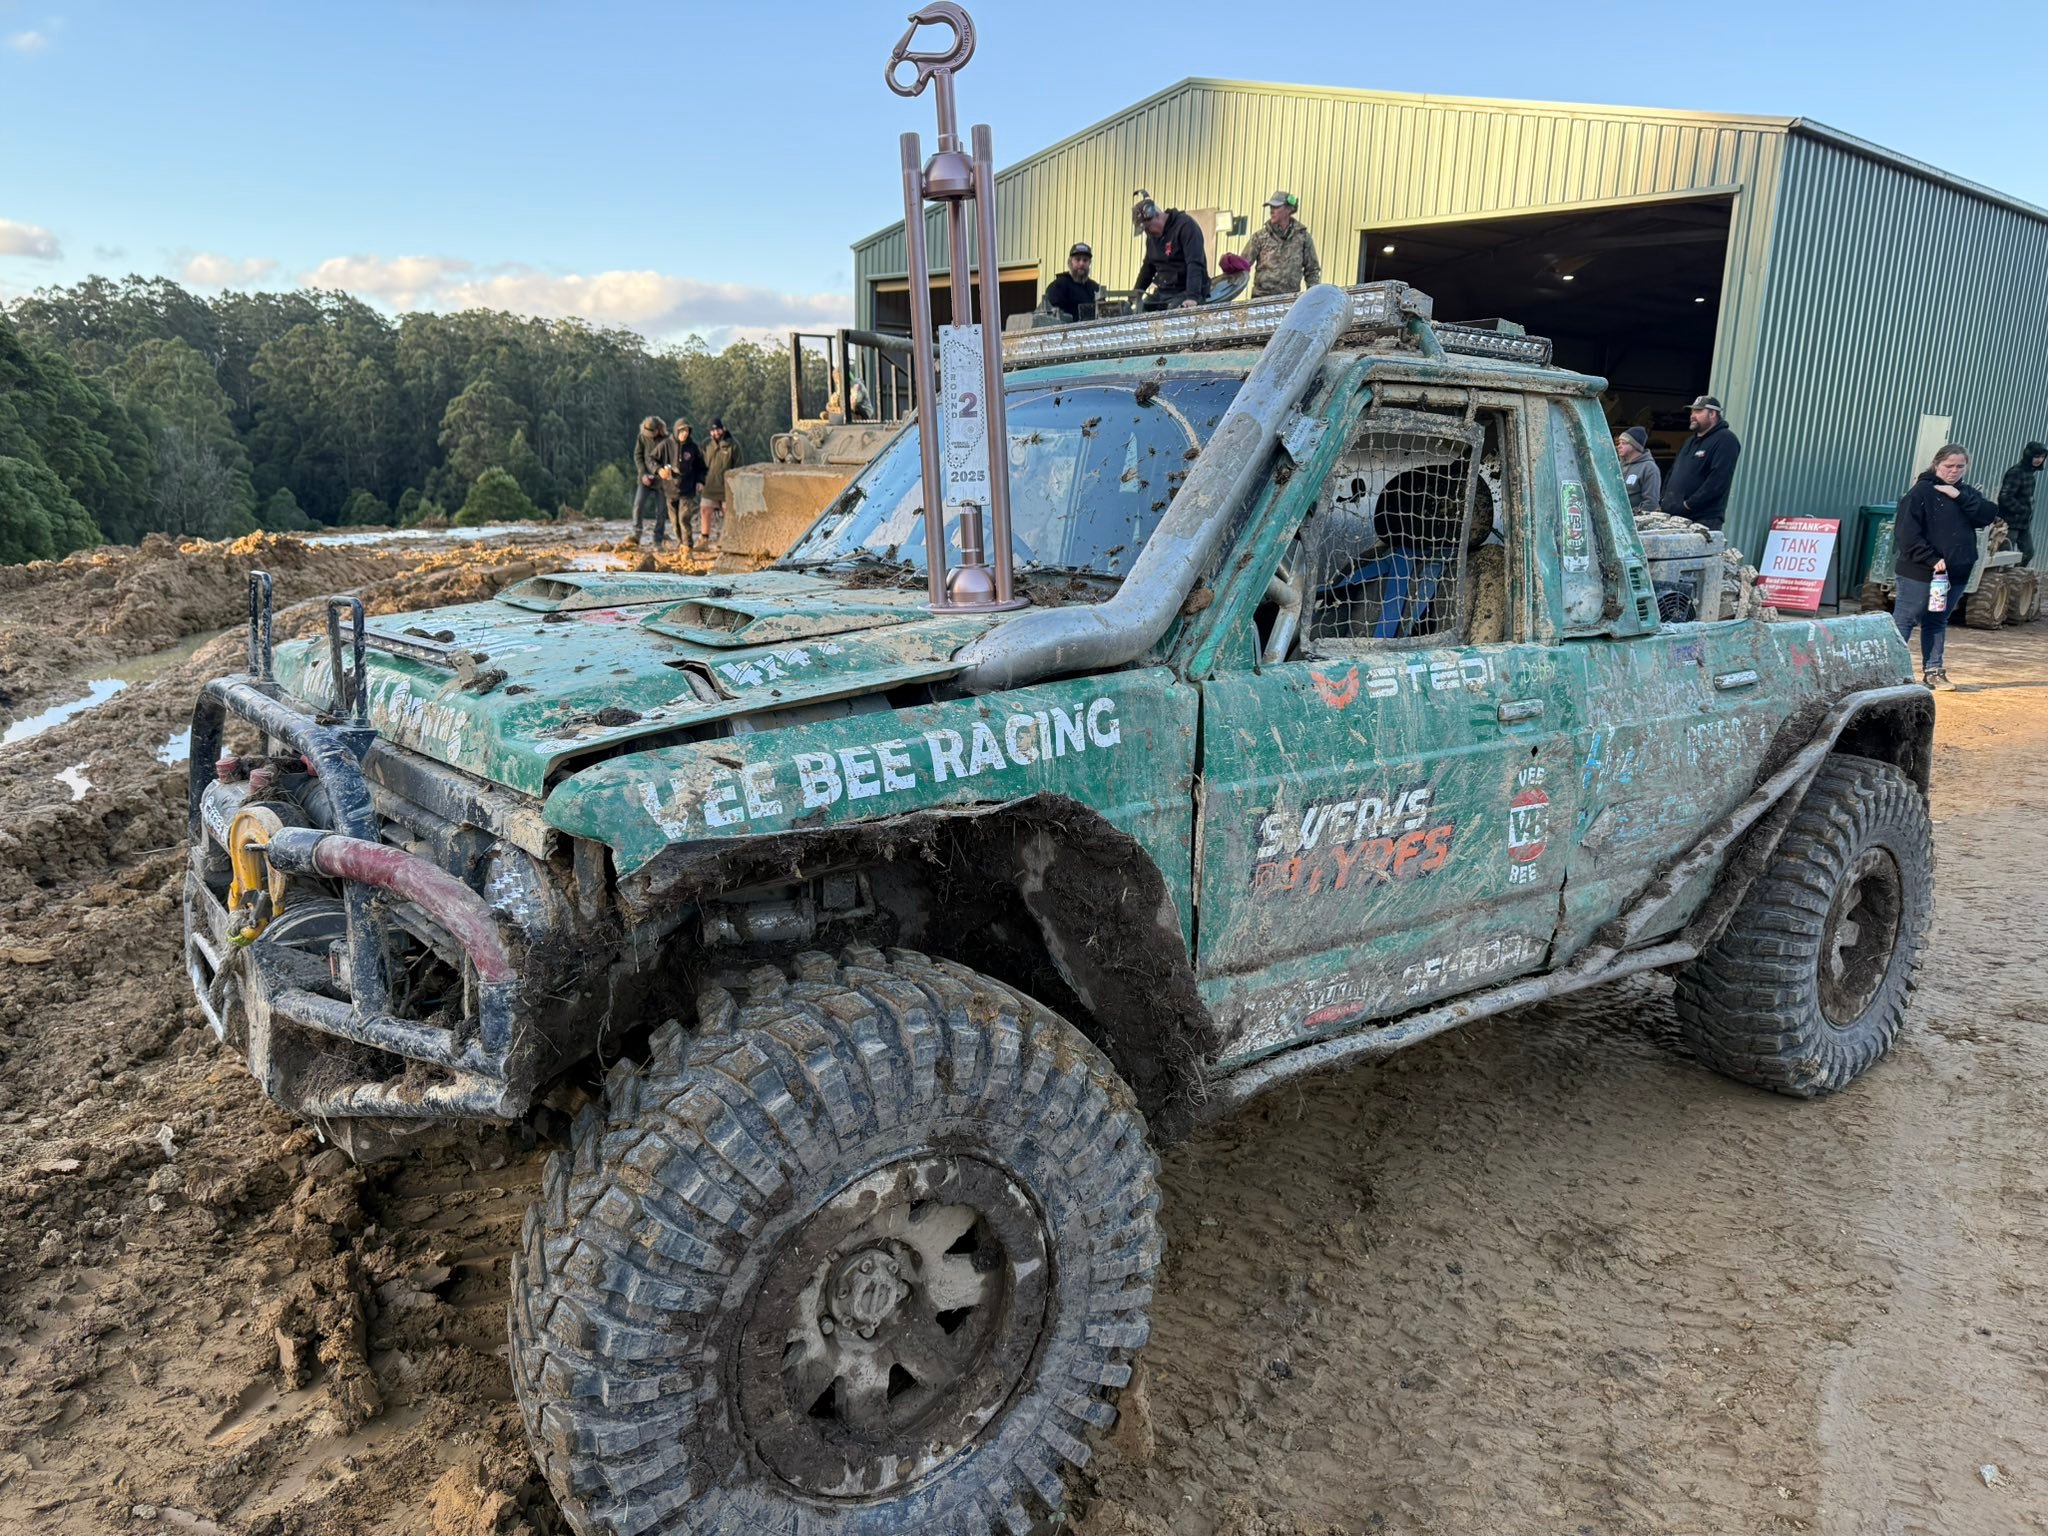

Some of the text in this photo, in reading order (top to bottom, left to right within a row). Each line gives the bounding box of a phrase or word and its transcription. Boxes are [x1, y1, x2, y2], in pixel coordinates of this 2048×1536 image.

[959, 392, 978, 418] 2
[951, 470, 986, 482] 2025
[1797, 522, 1820, 531] TANK
[1781, 538, 1820, 554] TANK
[1772, 556, 1817, 573] RIDES
[1366, 656, 1496, 699] STEDI
[637, 697, 1122, 841] VEE BEE RACING
